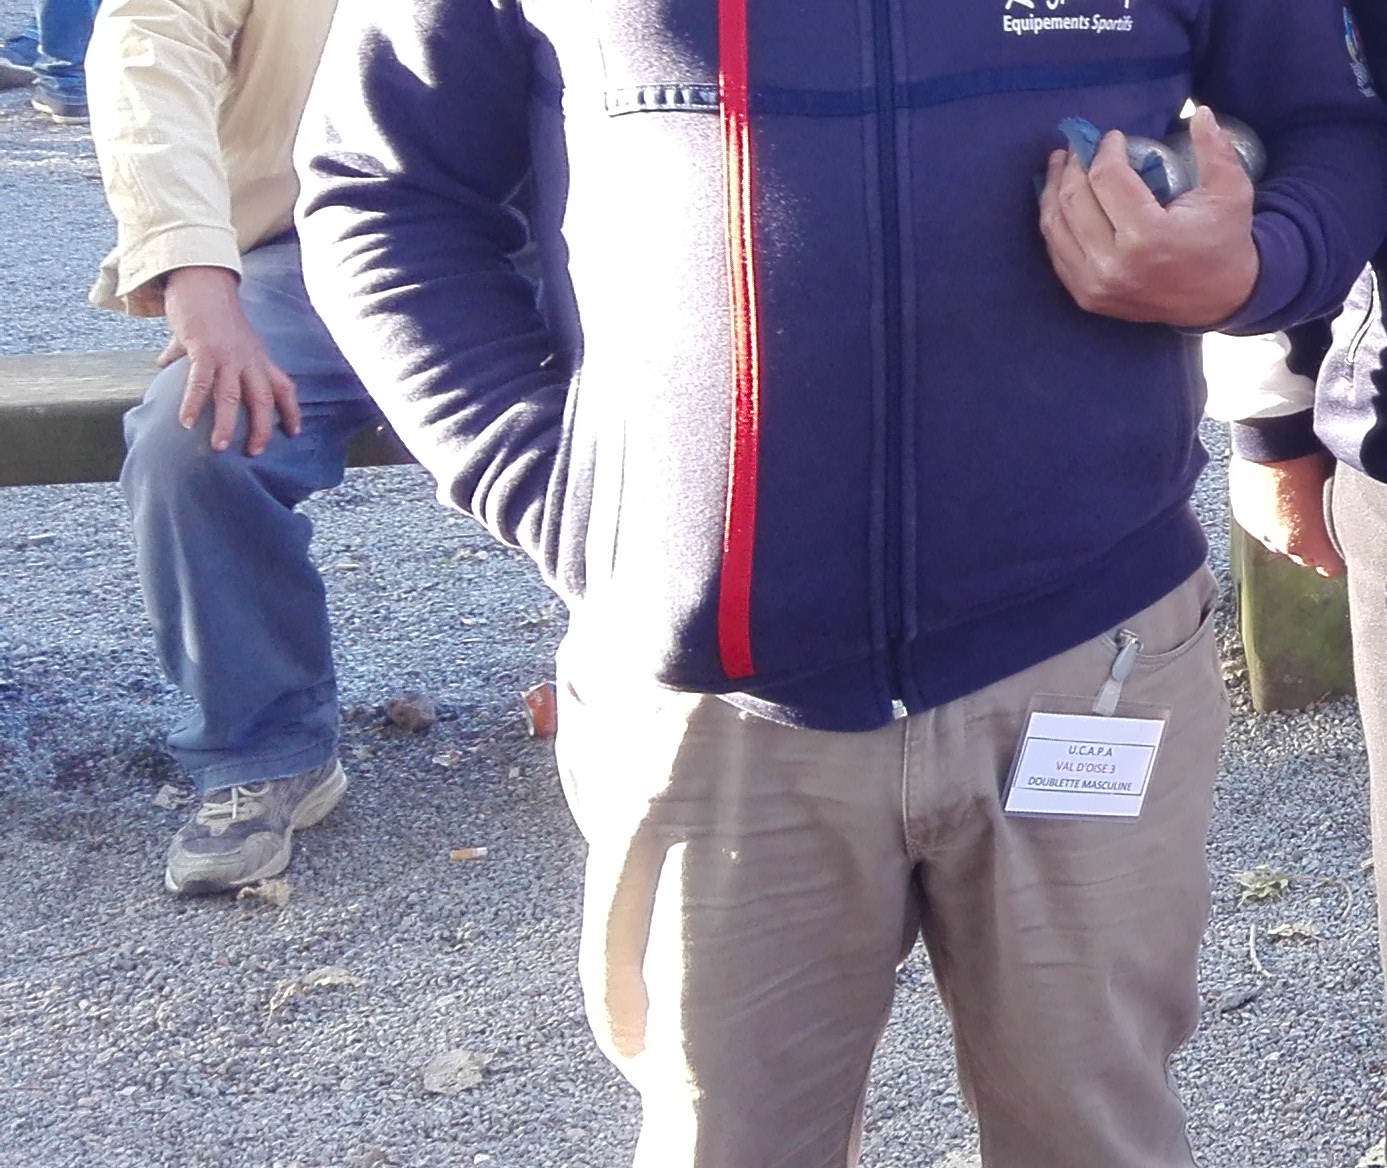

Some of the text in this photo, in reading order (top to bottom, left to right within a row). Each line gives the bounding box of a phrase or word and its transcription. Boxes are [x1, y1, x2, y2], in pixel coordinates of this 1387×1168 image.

[1003, 14, 1133, 36] Equipements Sportifs
[1056, 760, 1074, 773] VAL
[1109, 764, 1117, 774] 3
[1028, 776, 1132, 791] DOUBLETTE MASCULINE
